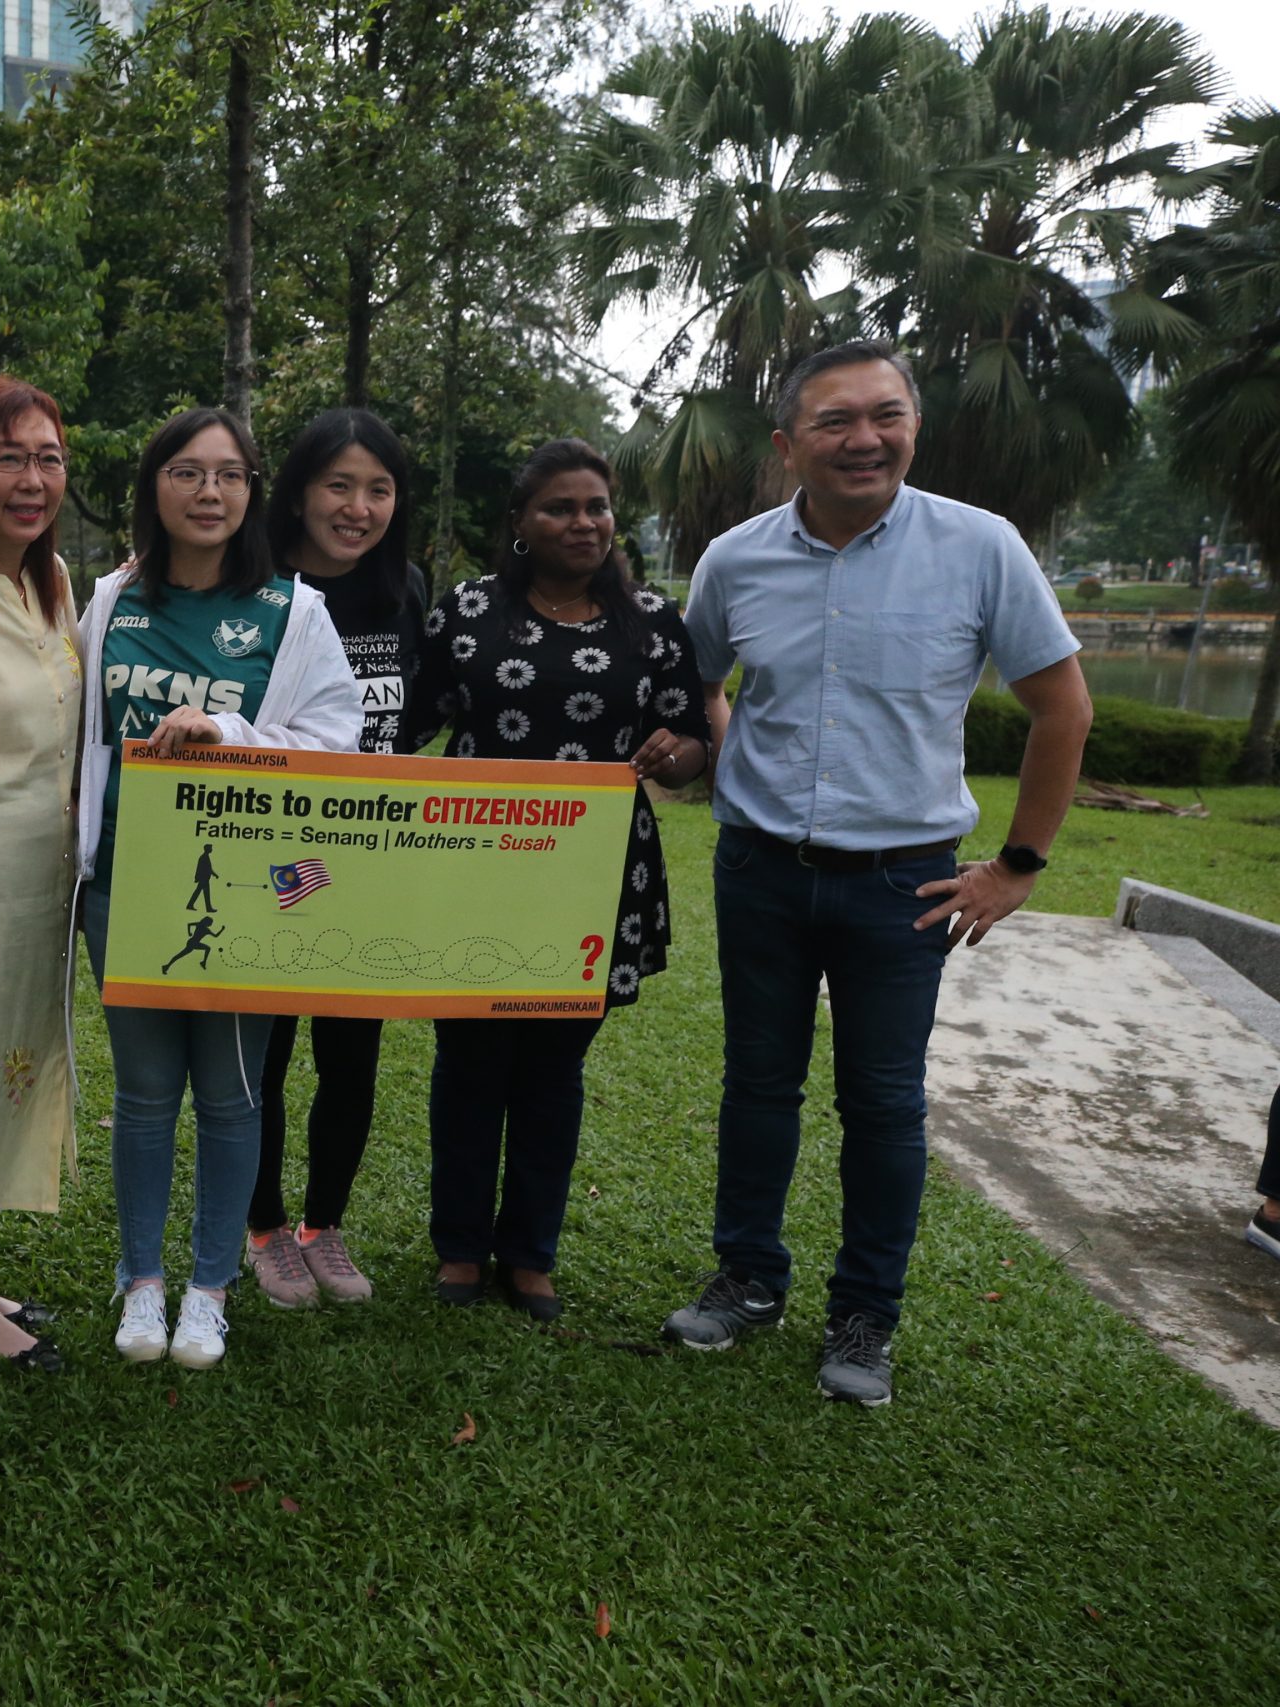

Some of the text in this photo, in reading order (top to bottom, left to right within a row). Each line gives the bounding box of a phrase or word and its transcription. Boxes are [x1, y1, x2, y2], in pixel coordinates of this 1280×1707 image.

[105, 663, 245, 713] PKNS
[131, 747, 288, 767] #SAYJUGAANAKMALAYSIA
[175, 783, 587, 826] Rights to confer CITIZENSHIP
[195, 820, 274, 841] Fathers
[281, 831, 294, 840] =
[300, 826, 378, 850] Senang
[394, 831, 476, 850] Mothers
[482, 838, 493, 848] =
[498, 833, 556, 851] Susah
[580, 934, 604, 982] ?
[491, 1001, 600, 1012] #MANADOKUMENKAMI
